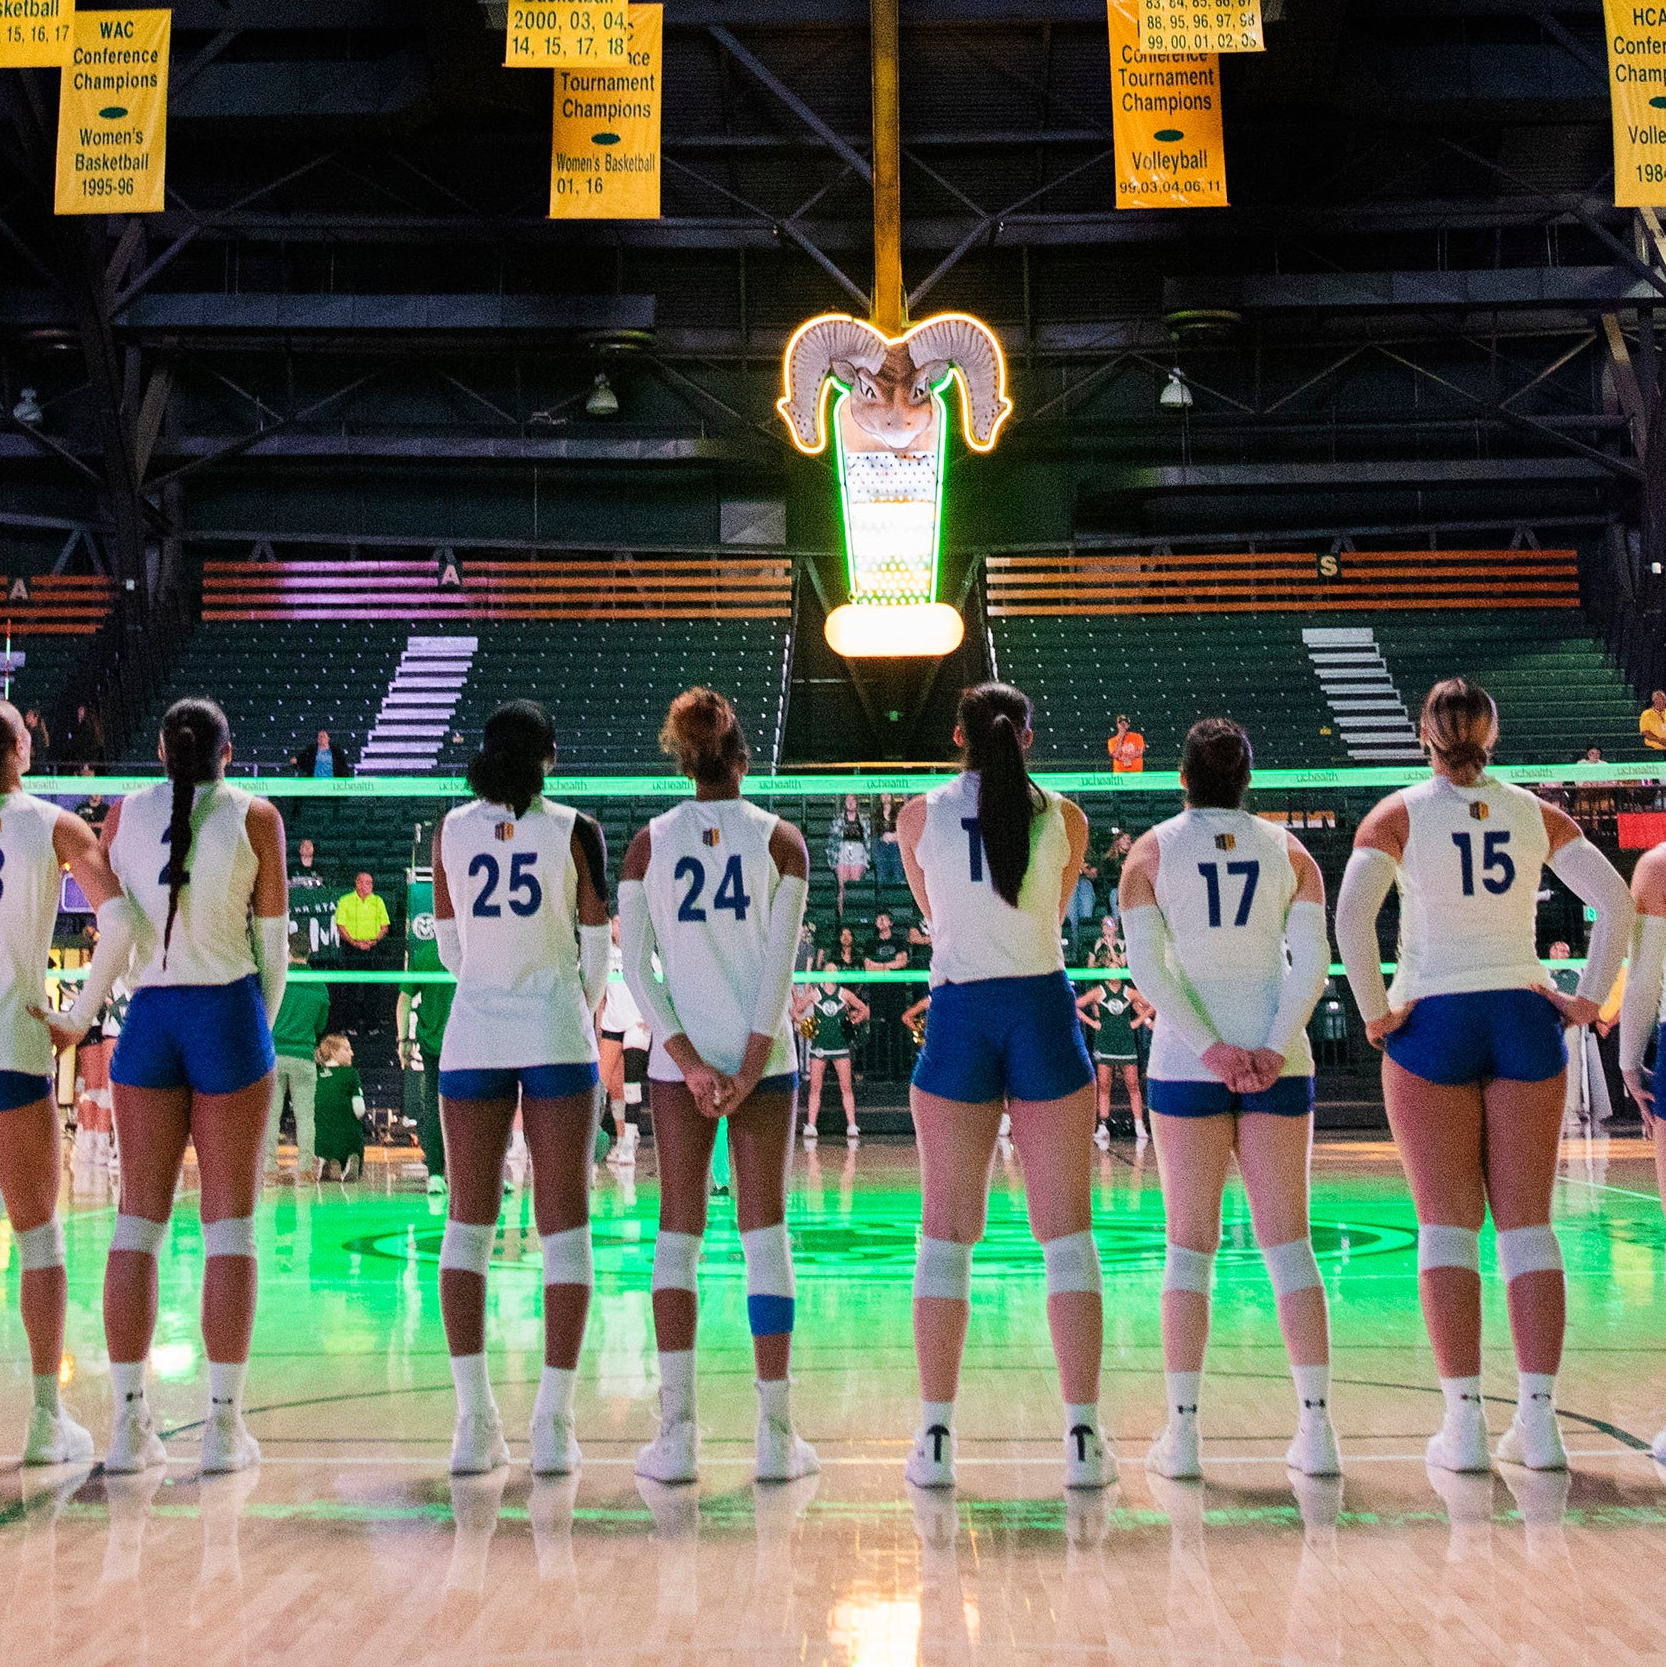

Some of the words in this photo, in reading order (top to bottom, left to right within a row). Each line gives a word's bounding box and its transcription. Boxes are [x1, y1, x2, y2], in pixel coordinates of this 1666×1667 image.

[100, 21, 134, 40] WAC
[514, 11, 562, 33] 2000,
[570, 11, 596, 33] 03,
[603, 10, 627, 32] 04,
[1170, 15, 1189, 32] 95,
[1193, 14, 1212, 31] 96,
[8, 25, 25, 44] 15,
[55, 24, 70, 42] 17
[1148, 35, 1167, 52] 99,
[73, 47, 158, 66] Conference
[513, 36, 535, 58] 14,
[545, 36, 567, 58] 15,
[577, 36, 598, 58] 17,
[608, 36, 624, 56] 18
[74, 73, 157, 93] Champions
[560, 71, 655, 93] Tournament
[1118, 66, 1214, 88] Tournament
[562, 98, 651, 122] Champions
[1122, 92, 1212, 115] Champions
[79, 128, 143, 147] Women's
[74, 153, 149, 172] Basketball
[556, 152, 601, 173] Women's
[604, 151, 655, 172] Basketball
[1132, 151, 1208, 176] Volleyball
[82, 177, 134, 196] 1995-96
[556, 176, 580, 195] 01,
[585, 176, 603, 194] 16
[441, 564, 461, 585] A
[1320, 555, 1338, 576] S
[9, 578, 28, 600] A
[758, 779, 802, 791] uchealth
[1080, 773, 1124, 786] uchealth
[1451, 831, 1516, 897] 15
[468, 852, 543, 918] 25
[675, 854, 750, 922] 24
[1197, 860, 1260, 927] 17
